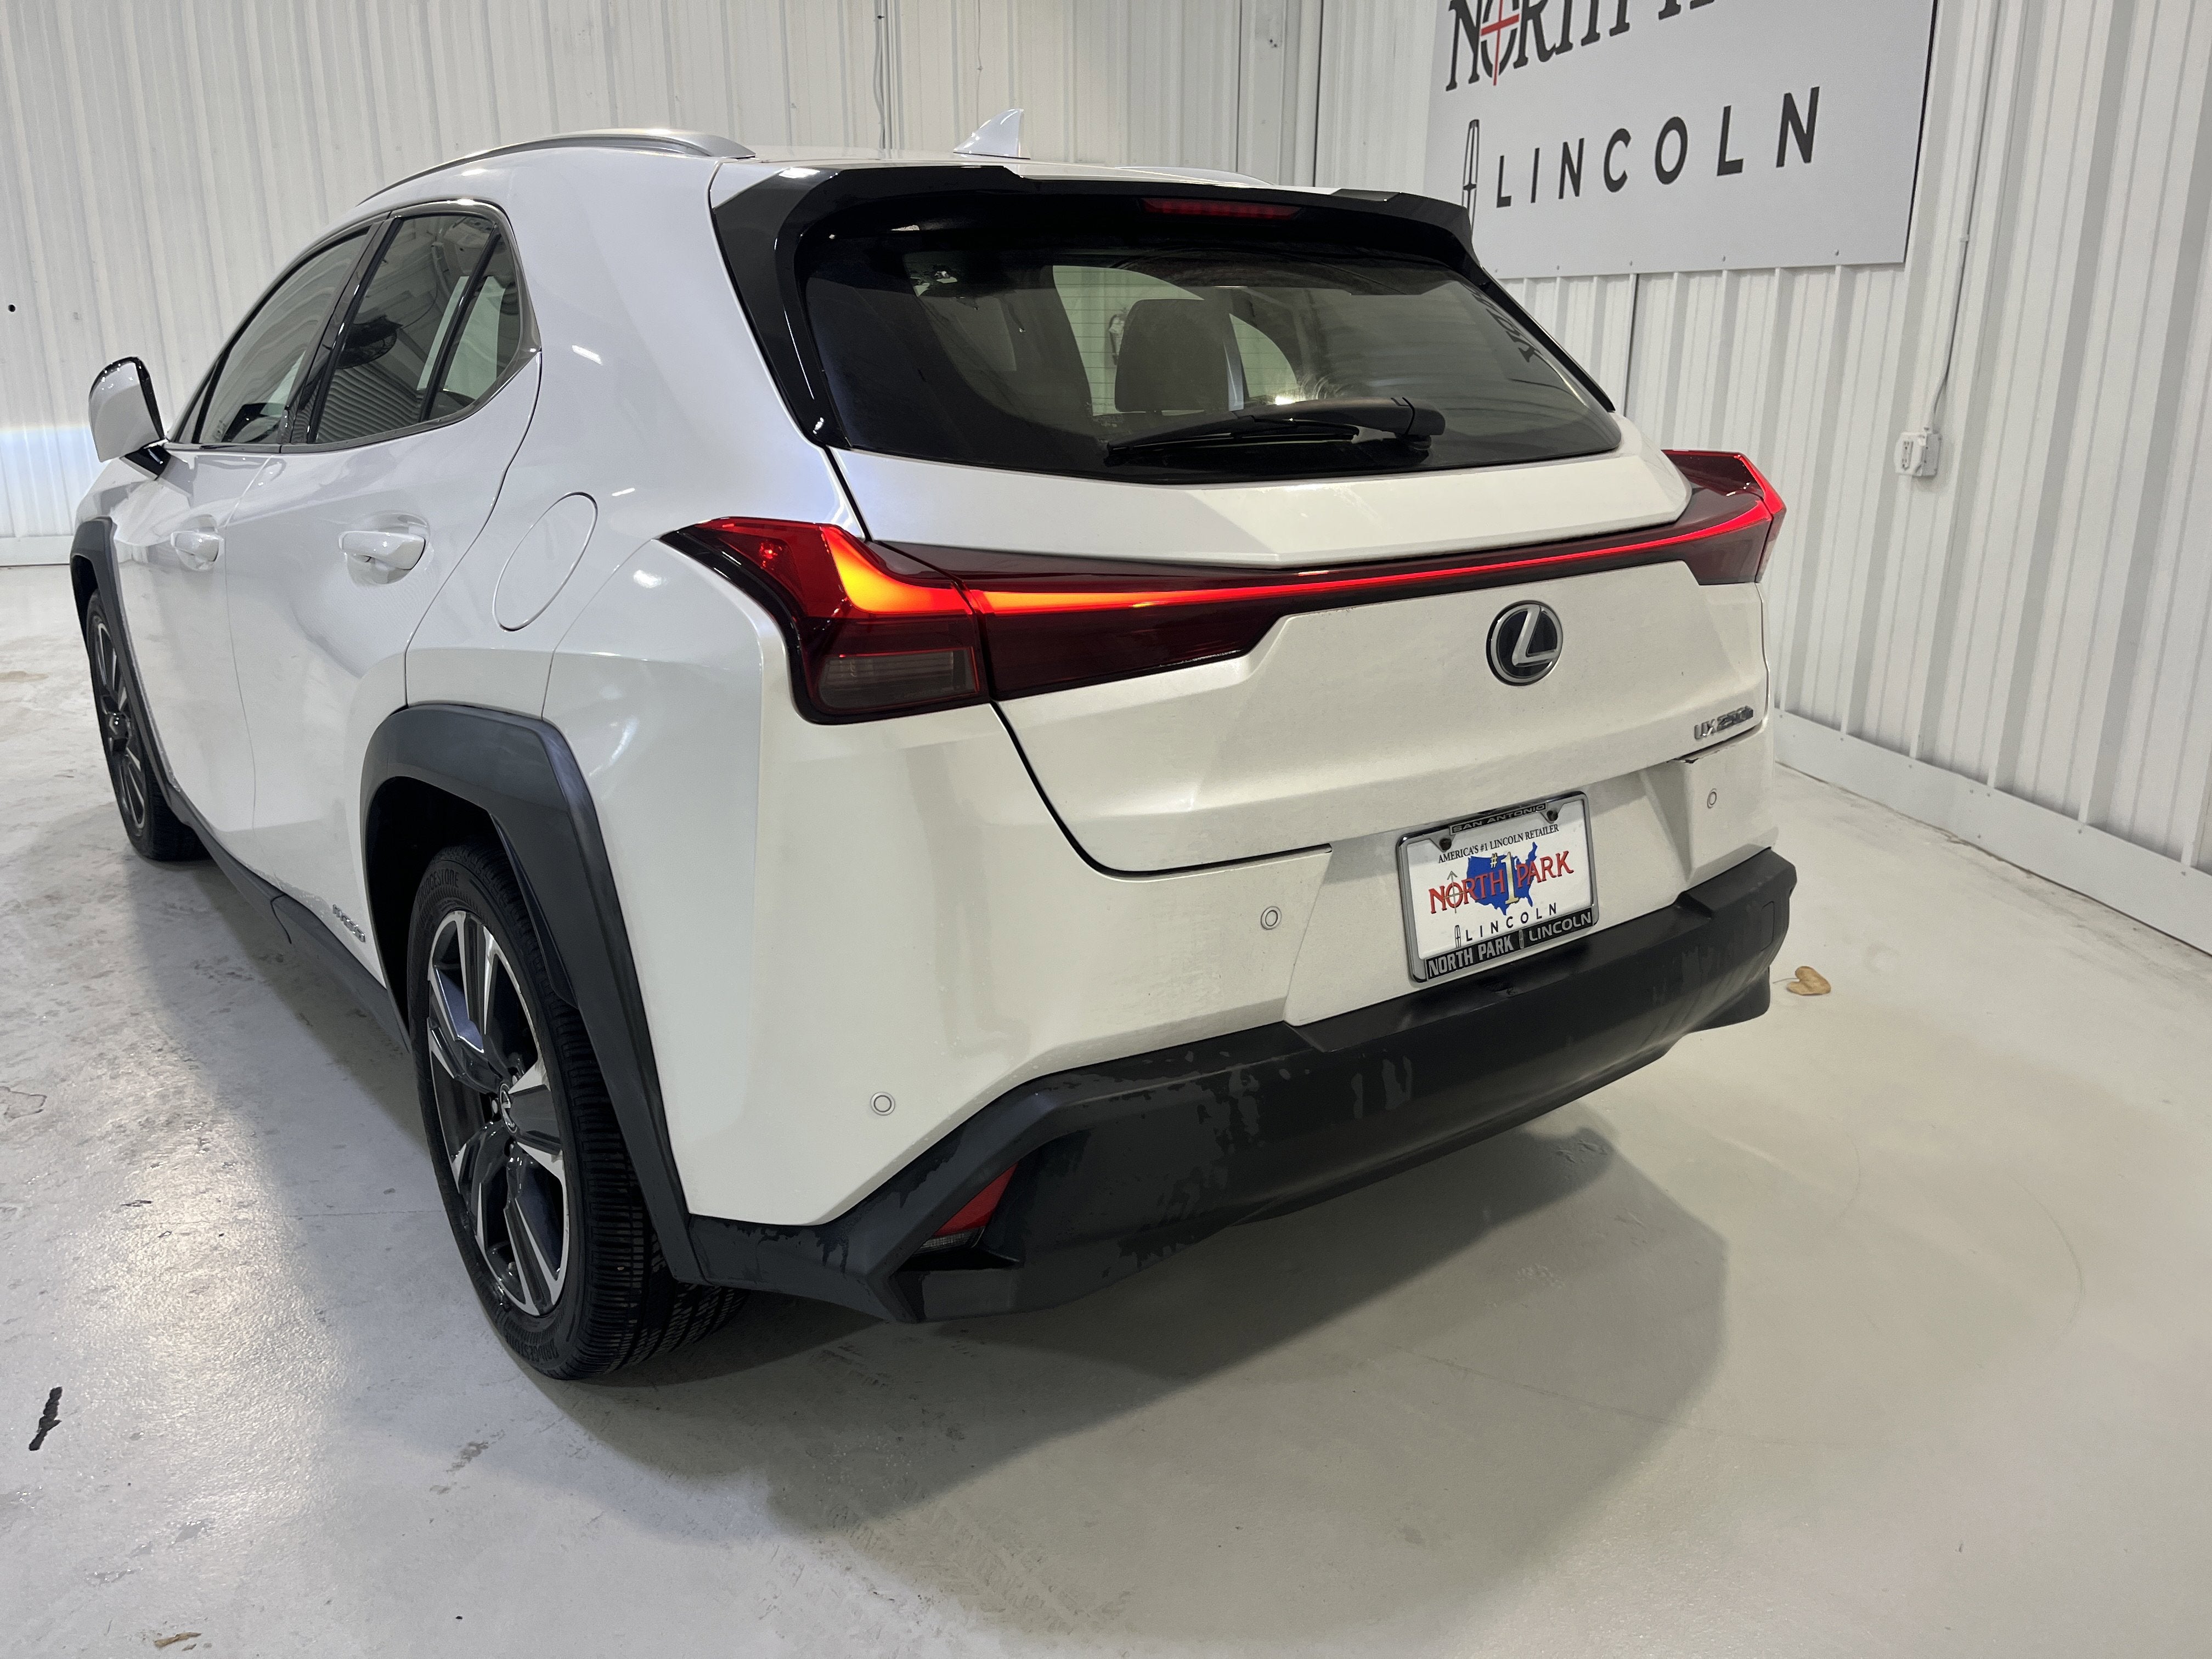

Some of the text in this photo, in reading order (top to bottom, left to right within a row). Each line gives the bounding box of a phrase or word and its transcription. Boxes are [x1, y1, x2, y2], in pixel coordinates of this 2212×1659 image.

[1496, 86, 1819, 207] LINCOLN
[1438, 824, 1559, 864] AMERICA'S #1 LINCOLN RETAILER
[1453, 804, 1545, 833] SAN ANTONIO
[1429, 850, 1574, 914] NORTH PARK
[1429, 912, 1591, 978] NORTH PARK LINCOLN
[1466, 902, 1556, 942] LINCOLN
